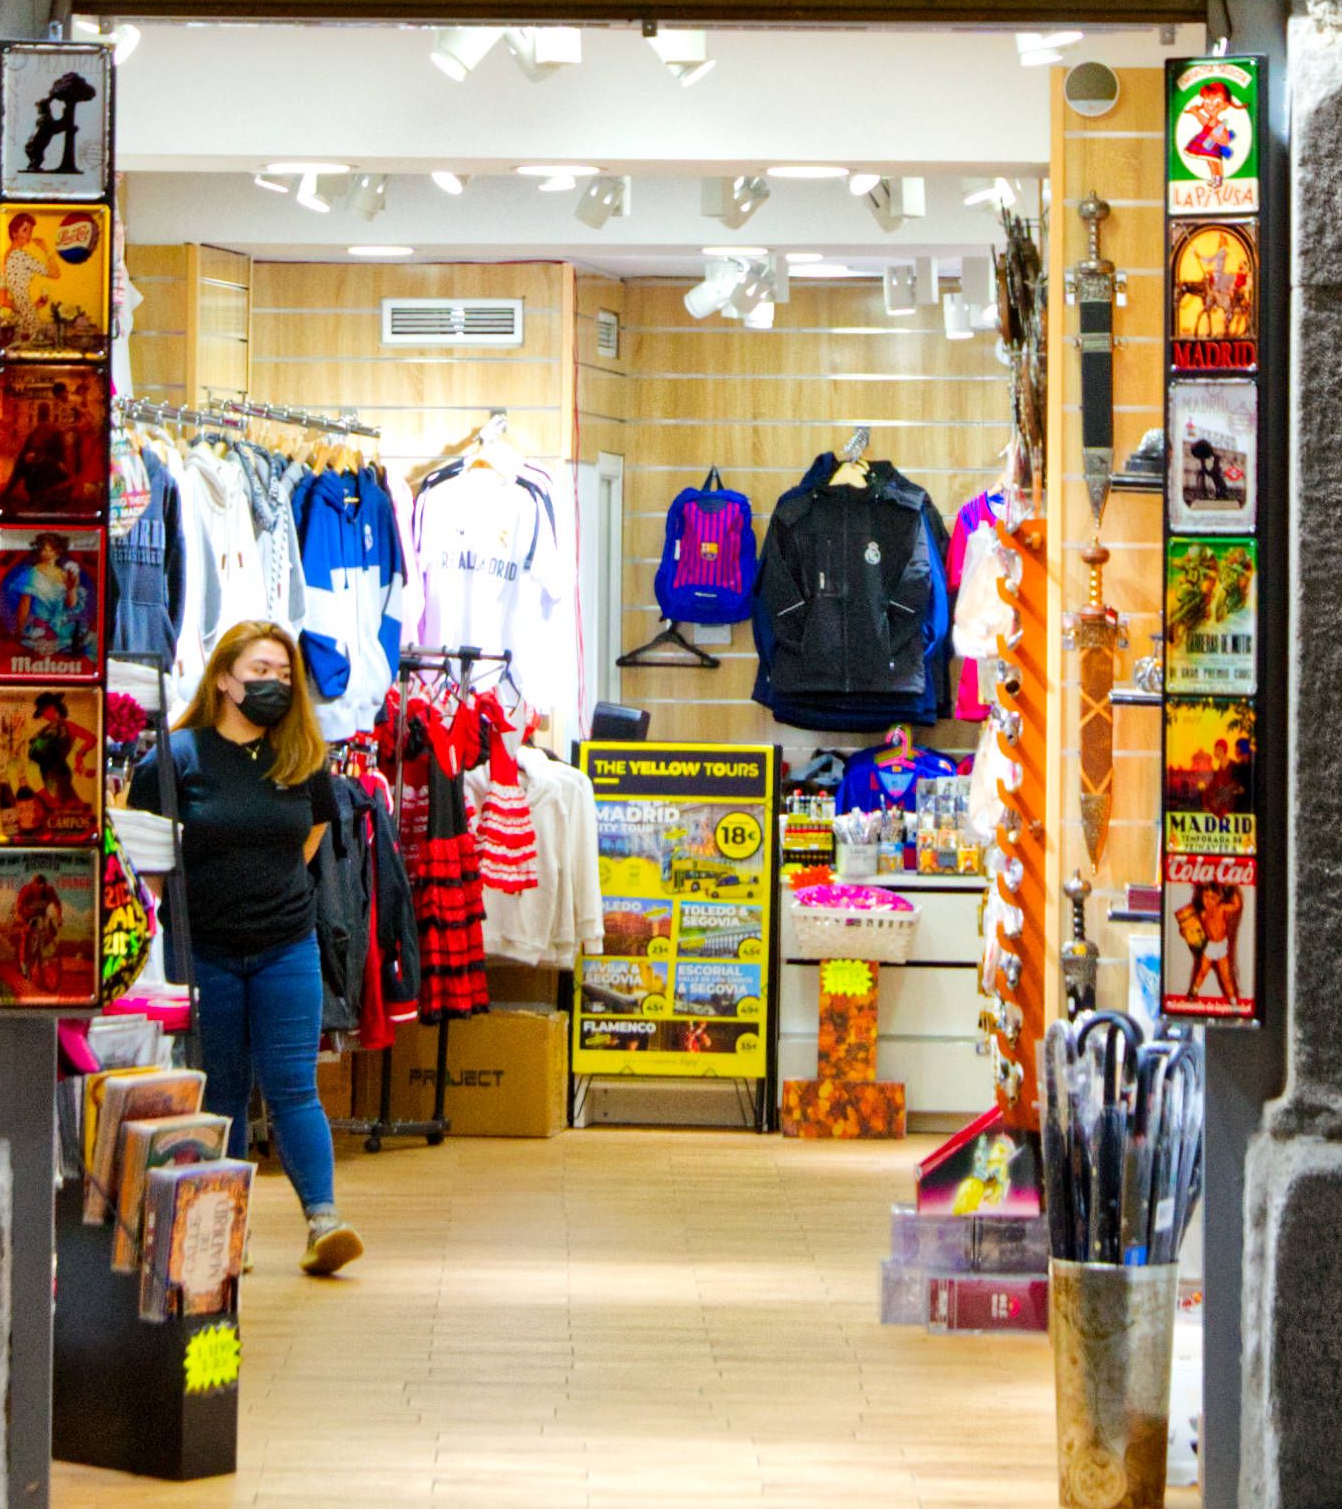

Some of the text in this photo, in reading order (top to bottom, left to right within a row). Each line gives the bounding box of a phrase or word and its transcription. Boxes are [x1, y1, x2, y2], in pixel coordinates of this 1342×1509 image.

[1174, 341, 1256, 368] MADRID
[442, 551, 475, 570] RAL
[11, 656, 82, 673] Mahou
[594, 760, 759, 777] THE YELLOW TOURS
[596, 805, 680, 823] MADRID
[1170, 815, 1252, 834] MADRID
[1169, 855, 1215, 883] Cola
[683, 905, 736, 916] TOLEDO
[683, 917, 740, 928] SEGOVIA
[678, 964, 742, 976] ESCORIAL
[587, 973, 643, 985] SEGOVIA
[690, 983, 748, 995] SEGOVIA
[583, 1021, 657, 1033] FLAMENCO
